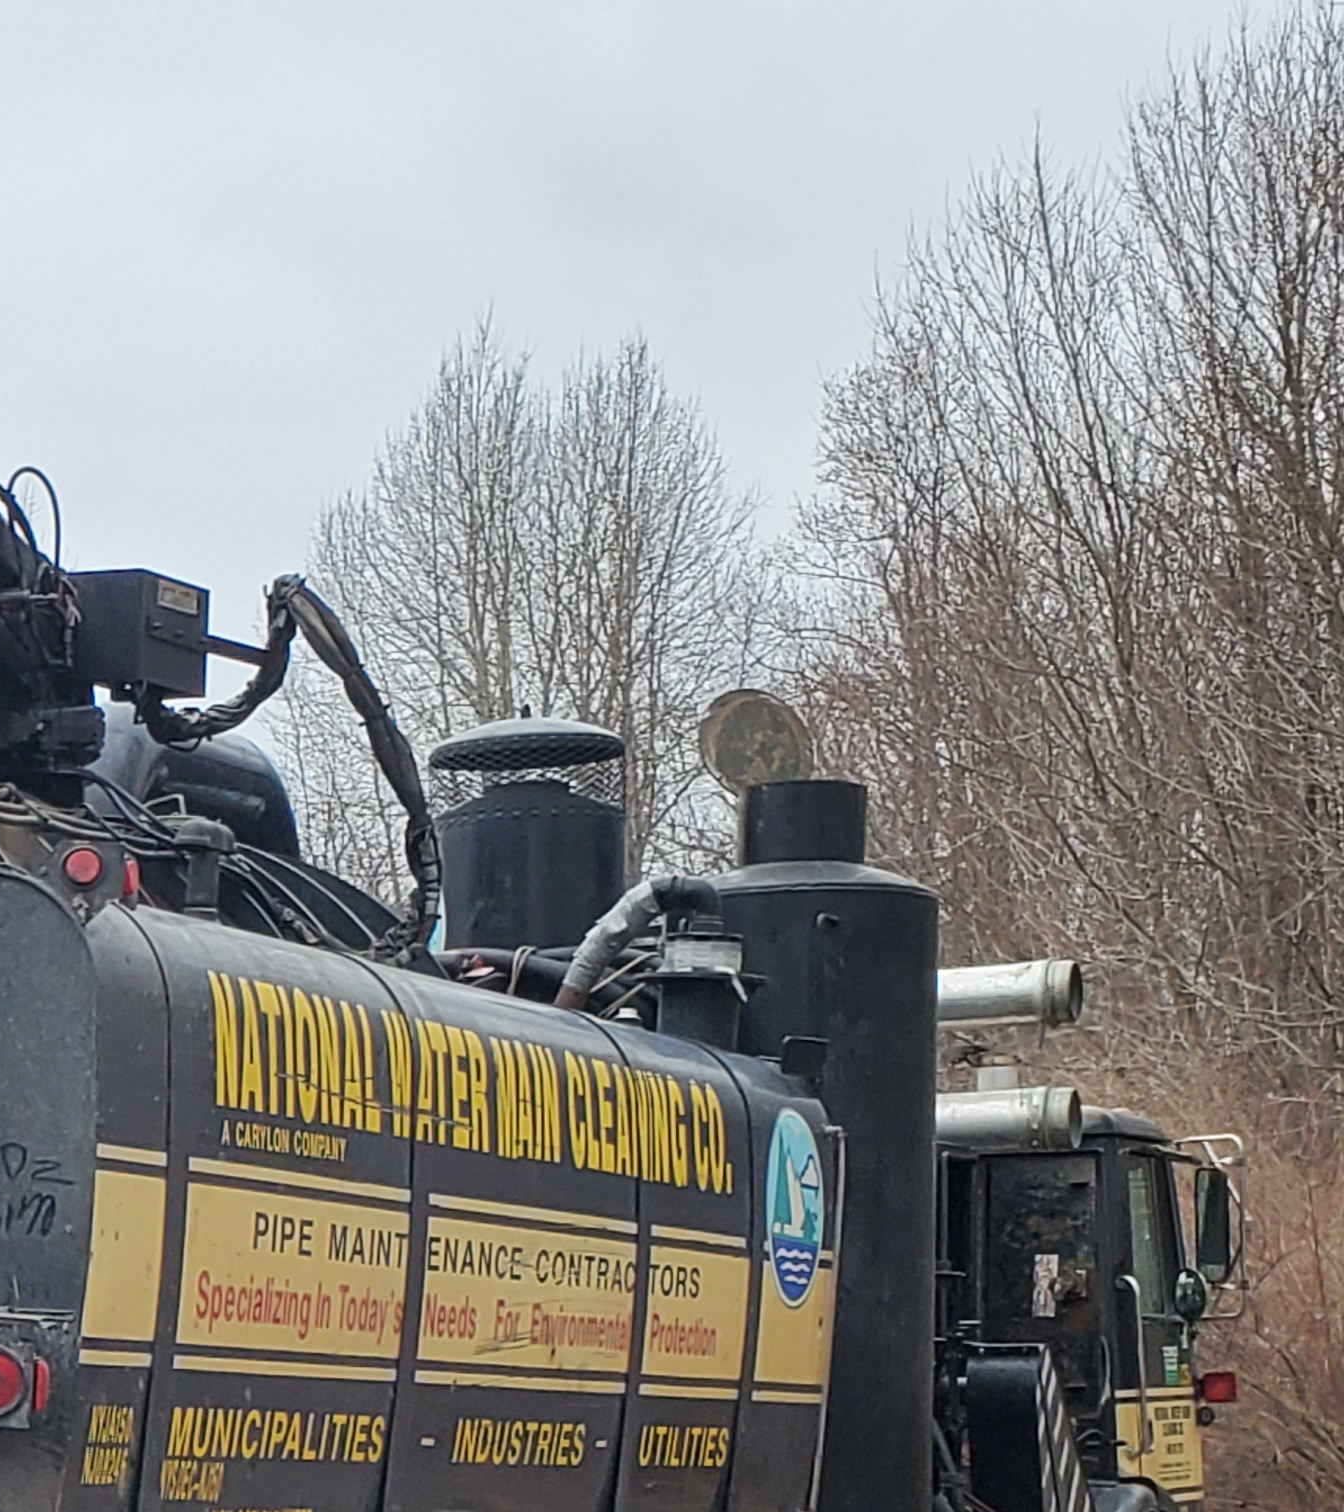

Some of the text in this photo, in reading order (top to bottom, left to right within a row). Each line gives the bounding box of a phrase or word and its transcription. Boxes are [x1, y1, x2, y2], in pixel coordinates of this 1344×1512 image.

[208, 969, 733, 1195] NATIONAL WATER MAIN CLEANING CO.
[221, 1119, 347, 1163] A CARYLON COMPANY
[252, 1211, 314, 1258] PIPE
[196, 1270, 718, 1357] Specializing In Today's Needs For Environmental Protection
[167, 1406, 386, 1463] MUNICIPALITIES
[451, 1417, 587, 1467] INDUSTRIES
[639, 1424, 730, 1468] UTILITIES
